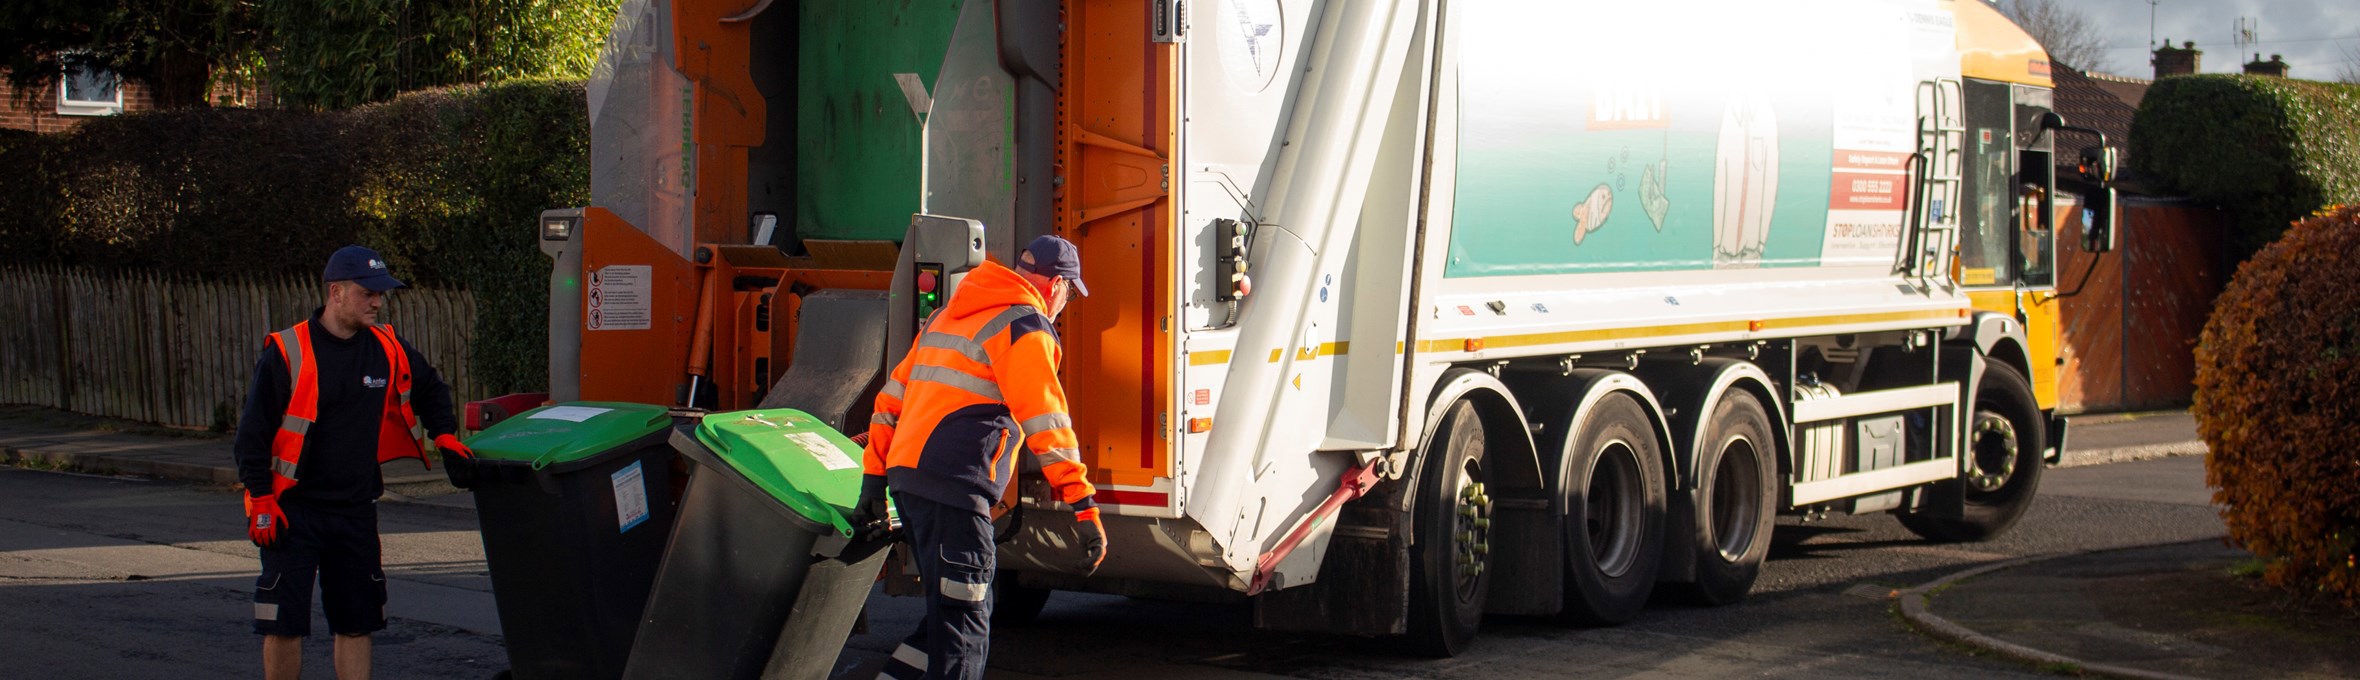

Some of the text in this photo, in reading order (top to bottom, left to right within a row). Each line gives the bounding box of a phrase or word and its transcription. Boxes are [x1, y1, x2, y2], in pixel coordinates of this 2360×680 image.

[1935, 15, 1953, 28] EAGLE
[682, 87, 692, 188] TERBERG
[1852, 179, 1892, 194] 0300 555 2222
